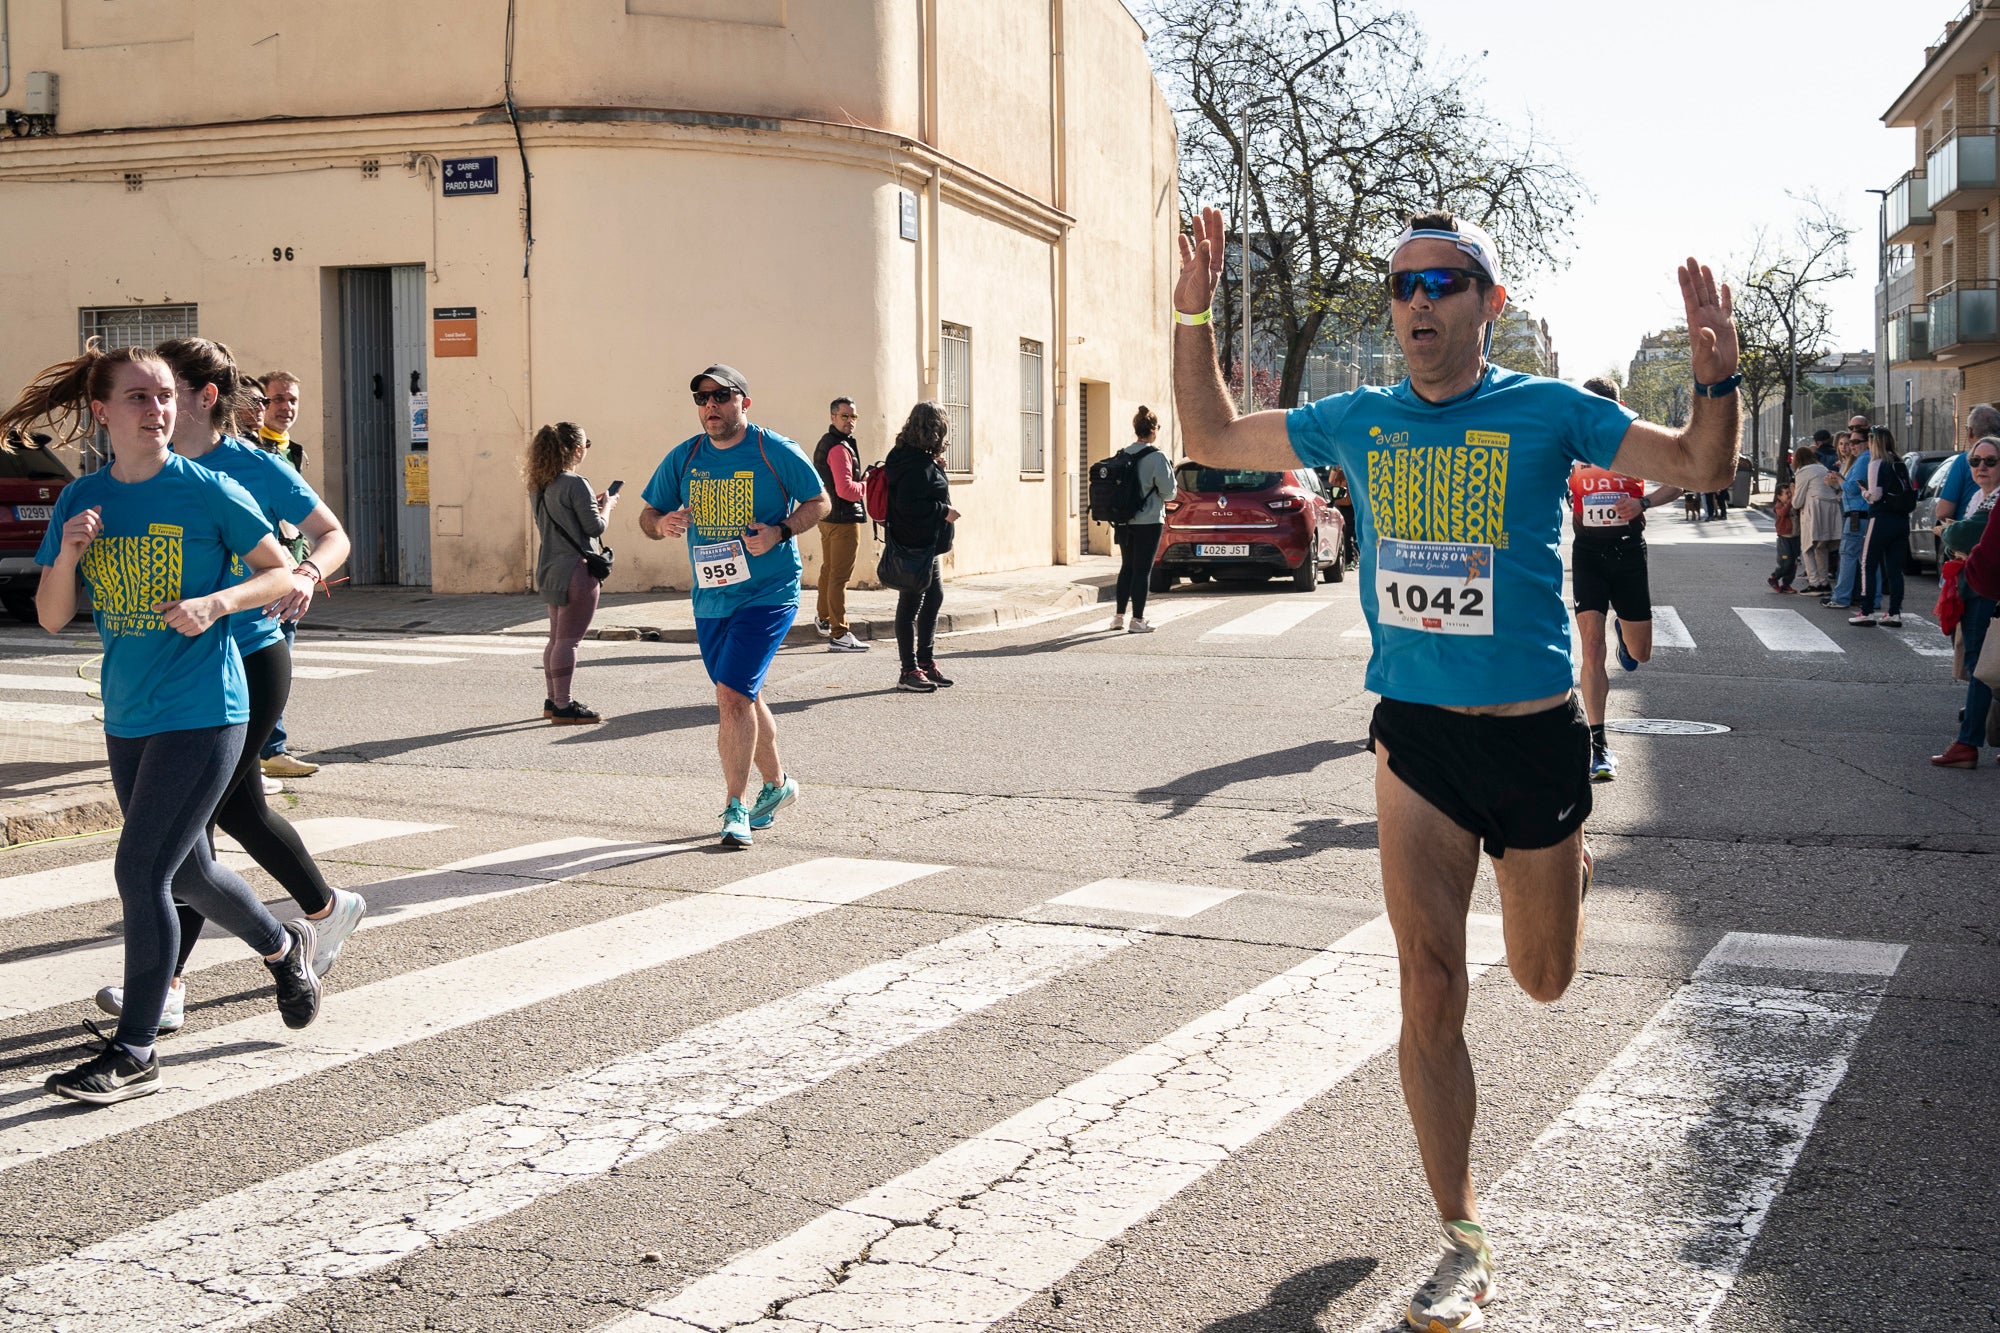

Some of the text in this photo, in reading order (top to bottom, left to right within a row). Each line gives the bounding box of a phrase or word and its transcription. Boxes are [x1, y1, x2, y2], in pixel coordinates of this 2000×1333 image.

[457, 162, 480, 171] CARRER
[445, 178, 493, 191] PARDO BAZÁN
[272, 246, 294, 262] 96
[1367, 446, 1509, 468] PARKINSON
[1582, 477, 1627, 491] UAT
[20, 507, 45, 519] 0299
[1588, 508, 1622, 520] 110
[1203, 546, 1247, 555] 4026 JST
[1395, 549, 1467, 562] PARKINSON
[703, 563, 737, 580] 958
[1386, 582, 1484, 617] 1042
